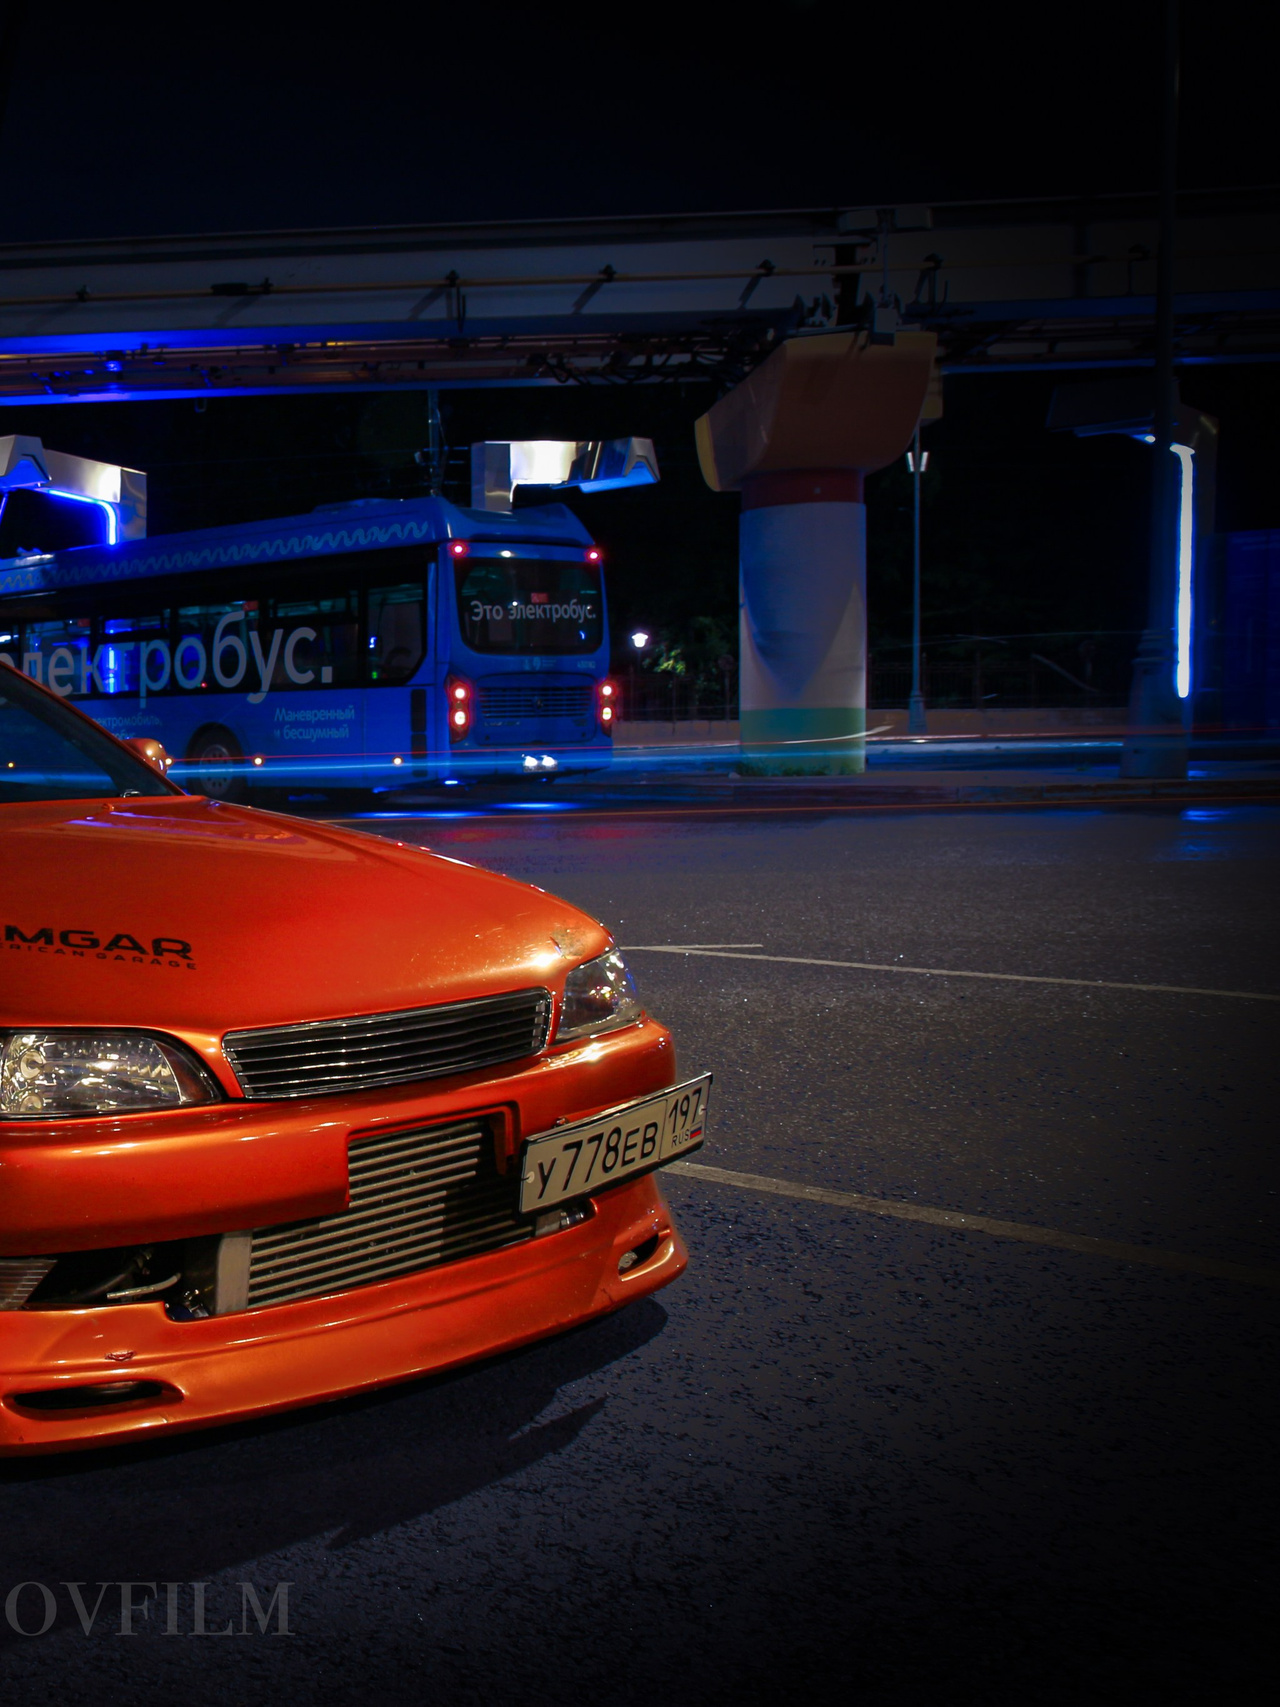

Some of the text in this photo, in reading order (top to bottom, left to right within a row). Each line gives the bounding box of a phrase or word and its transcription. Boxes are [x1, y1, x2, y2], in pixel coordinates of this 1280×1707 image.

[470, 598, 597, 623] Это электробус.
[274, 705, 355, 724] Маневренный
[274, 724, 350, 743] и бесшумный
[96, 952, 197, 970] GARAGE
[668, 1086, 703, 1134] 197
[671, 1129, 691, 1149] RUS
